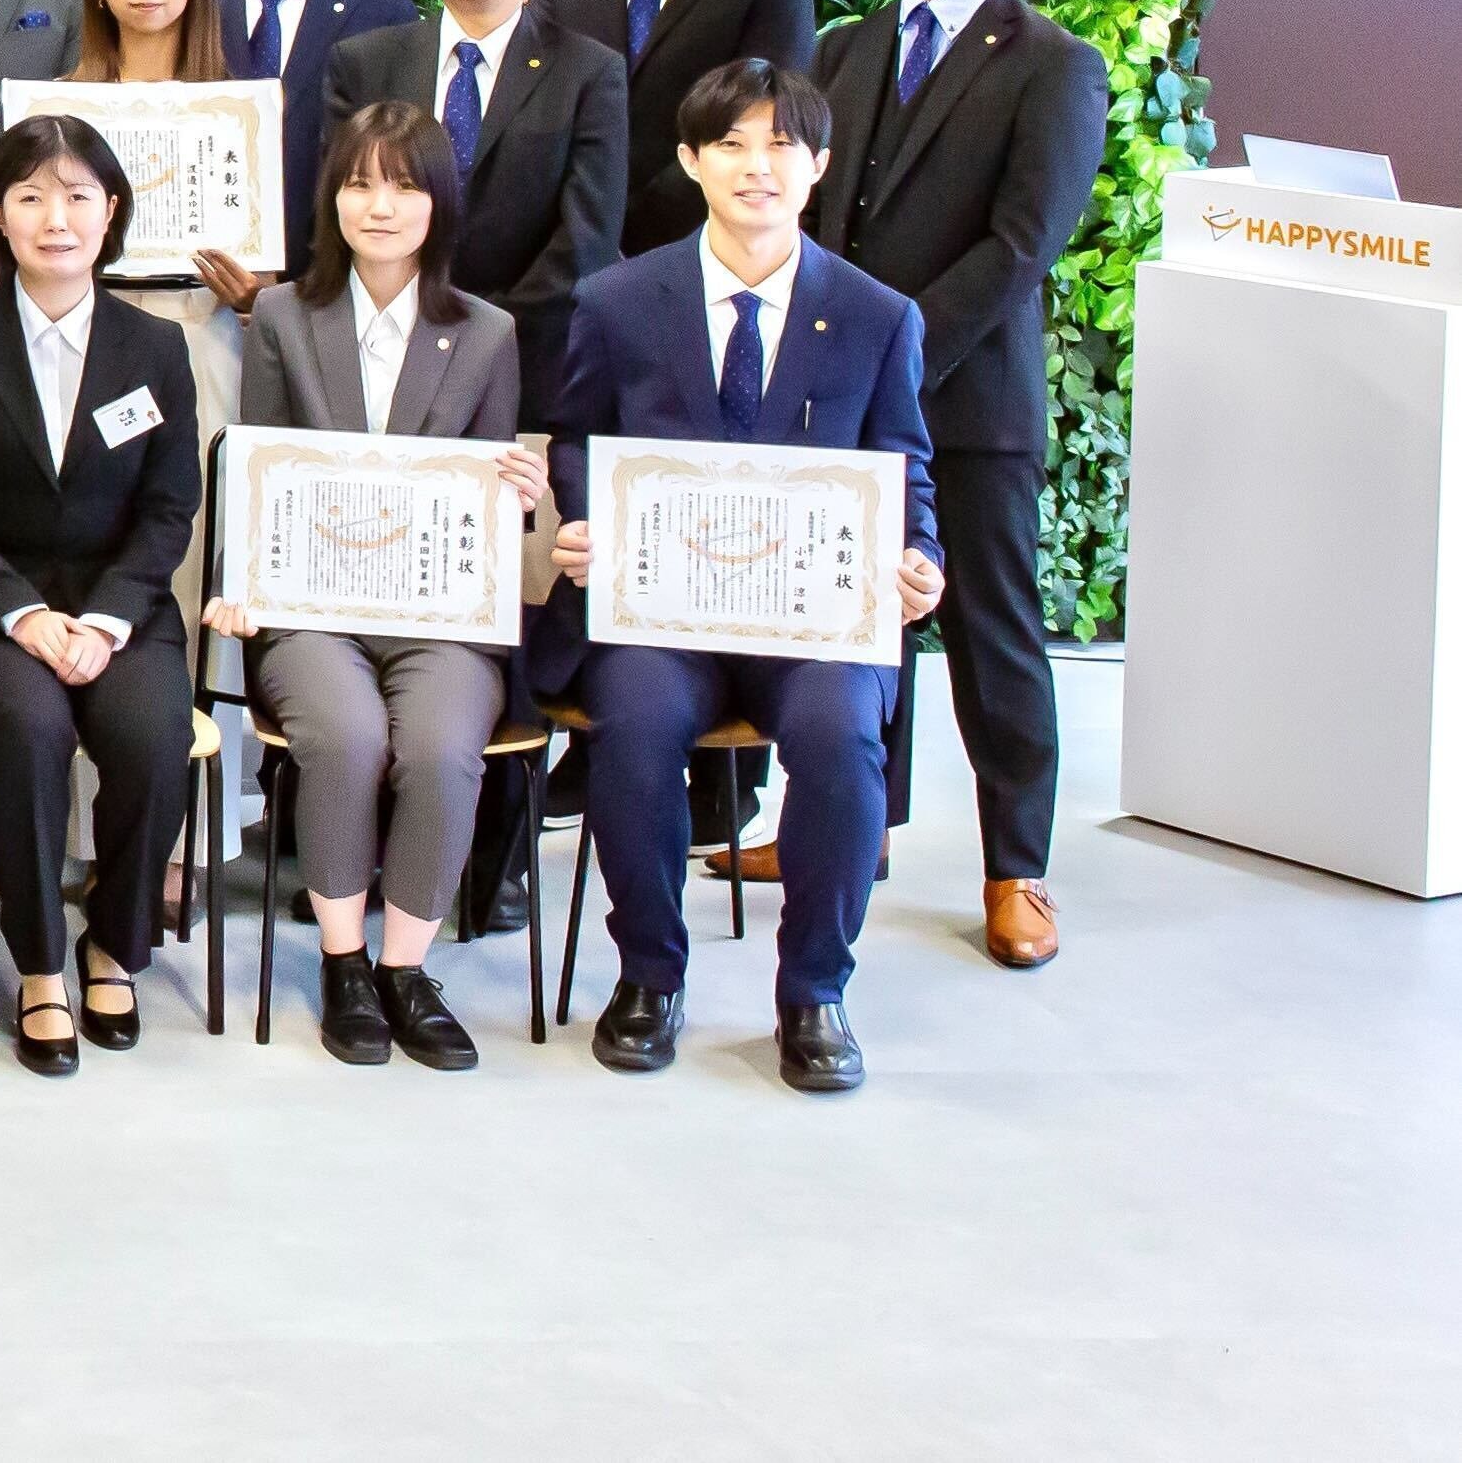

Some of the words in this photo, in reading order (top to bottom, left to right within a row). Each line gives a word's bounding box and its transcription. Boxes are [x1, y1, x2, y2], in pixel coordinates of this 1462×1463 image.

[223, 149, 240, 208] 表彰状
[1246, 217, 1431, 267] HAPPYSMILE
[456, 512, 476, 575] 表彰状
[835, 525, 854, 591] 表彰状
